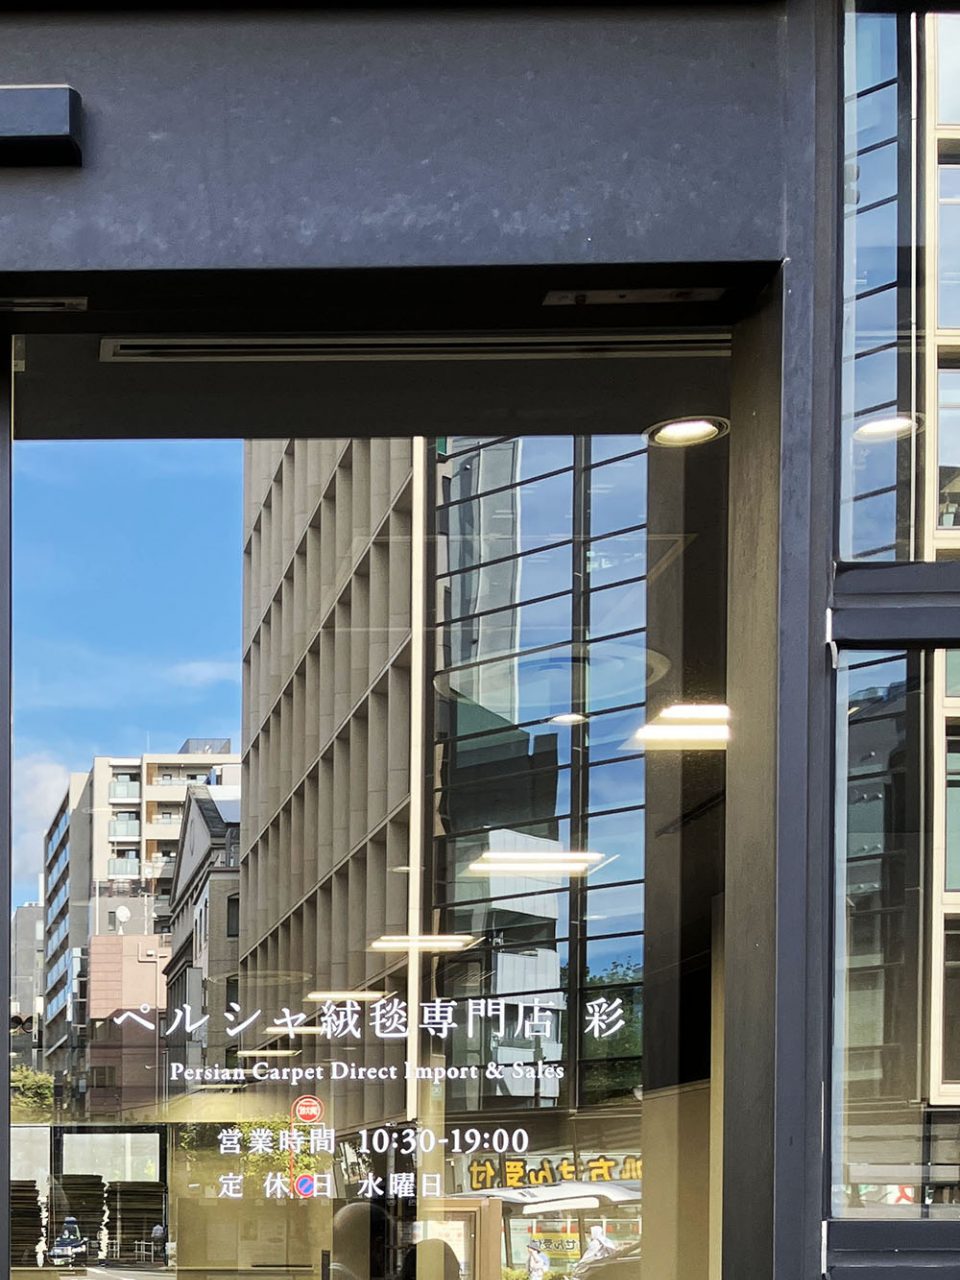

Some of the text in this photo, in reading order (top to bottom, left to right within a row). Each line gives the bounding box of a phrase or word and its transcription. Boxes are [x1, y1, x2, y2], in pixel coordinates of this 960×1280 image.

[113, 997, 626, 1040] ペルシャ絨毯専門店 彩
[170, 1060, 565, 1085] Persian Carpet Direct Import & Sales
[217, 1128, 530, 1155] 営業時間 10:30-19:00
[357, 1172, 442, 1199] 水曜日
